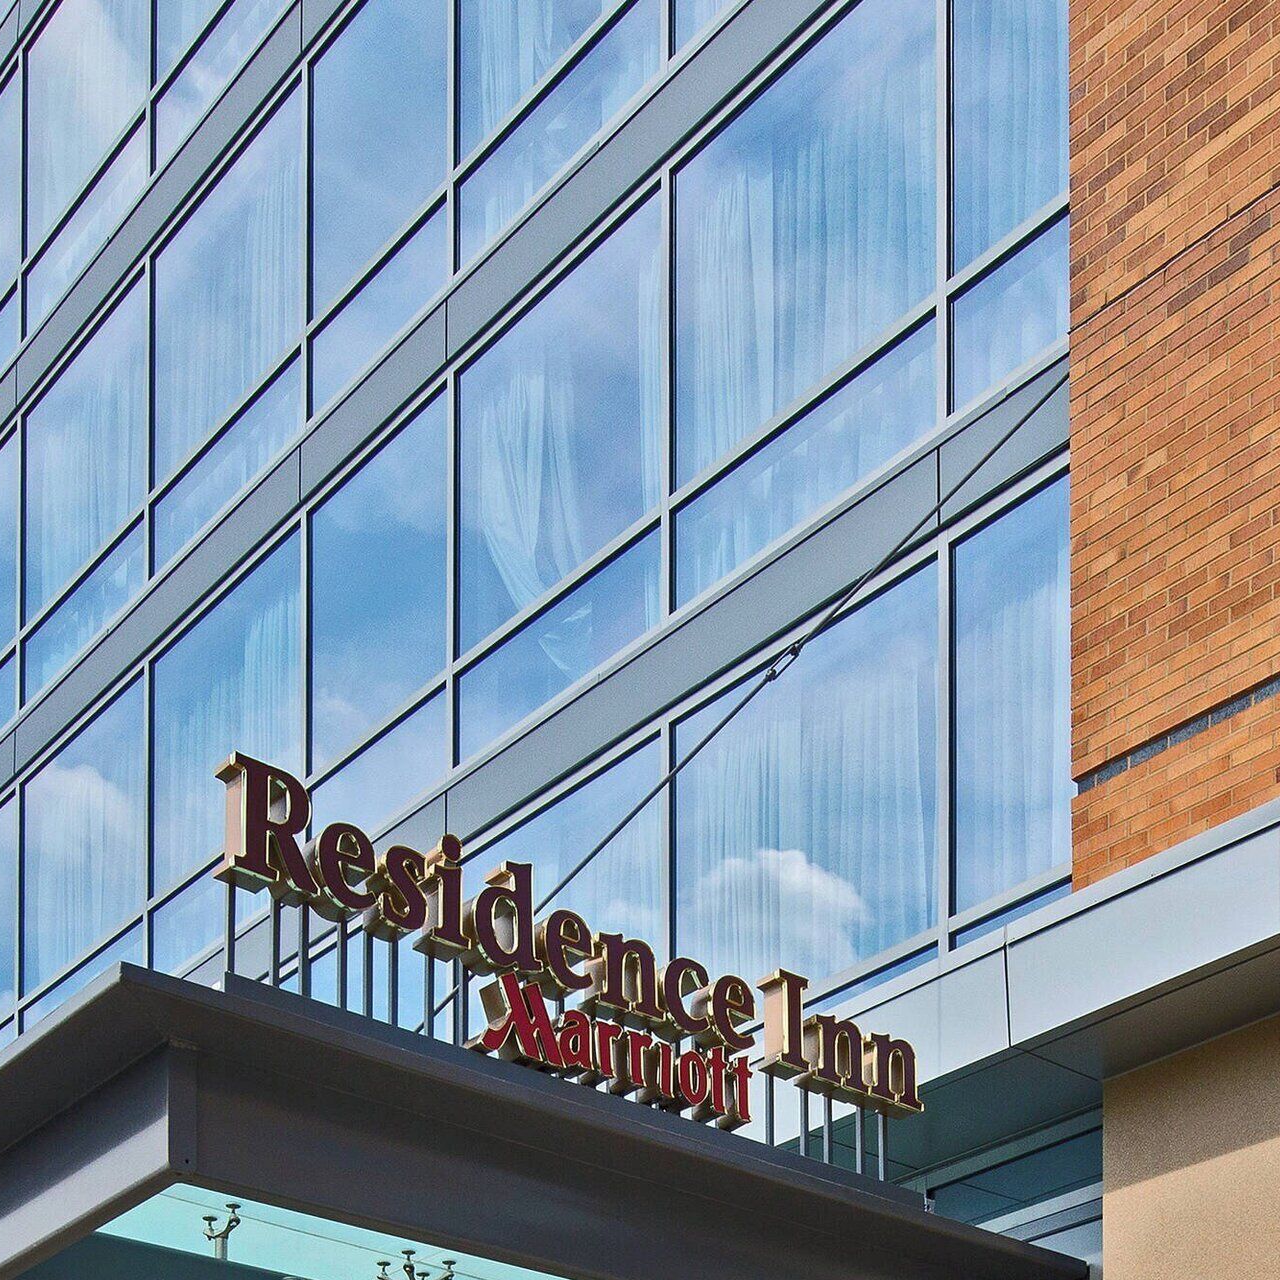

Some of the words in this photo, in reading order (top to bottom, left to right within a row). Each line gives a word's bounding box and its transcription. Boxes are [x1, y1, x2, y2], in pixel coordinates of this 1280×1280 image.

[215, 751, 757, 1050] Residence
[757, 968, 925, 1119] Inn
[467, 973, 753, 1131] Marriott
